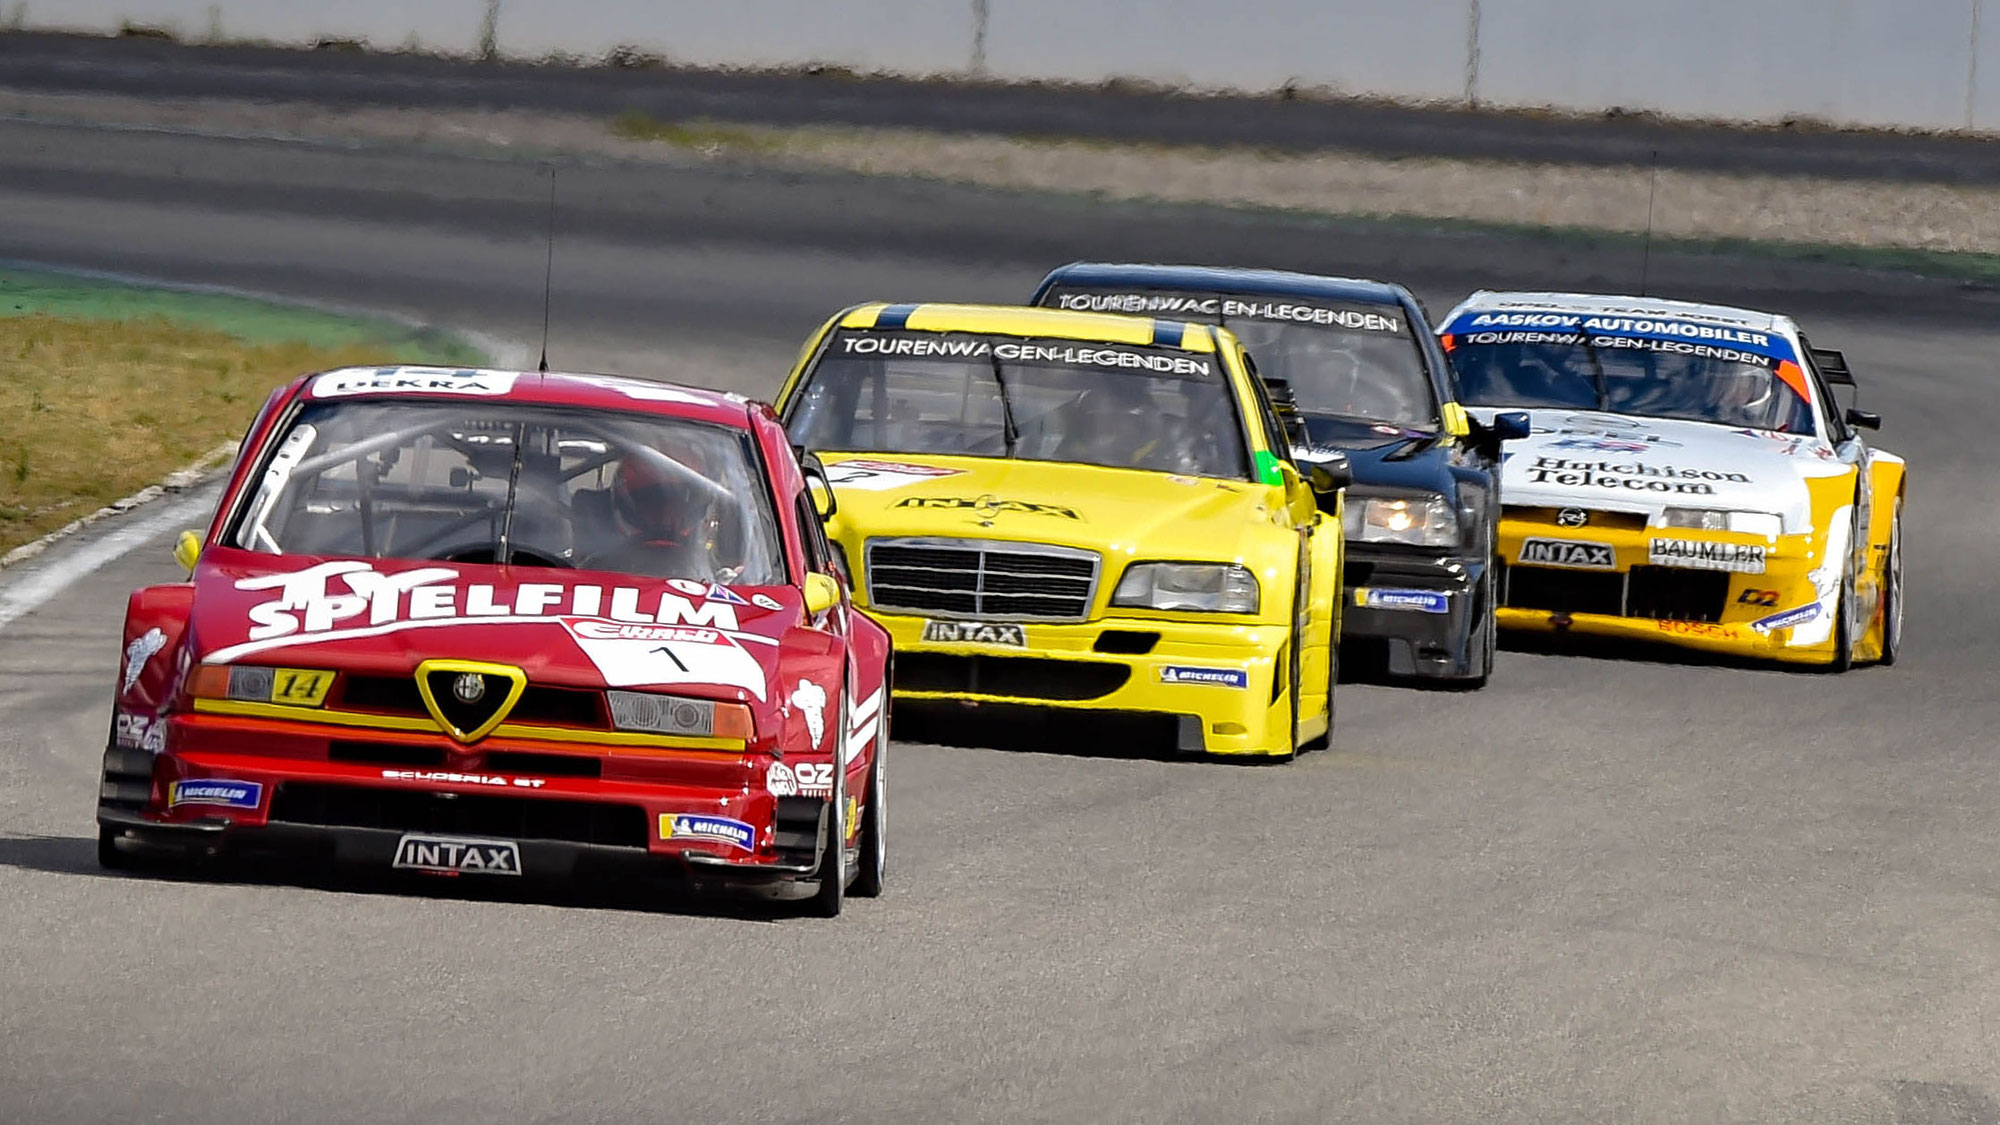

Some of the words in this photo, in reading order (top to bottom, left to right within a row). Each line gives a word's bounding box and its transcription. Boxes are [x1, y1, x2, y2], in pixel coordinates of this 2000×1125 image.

[1059, 294, 1398, 333] TOURENWAGEN-LEGENDEN
[1583, 317, 1769, 347] AUTOMOBILER
[844, 337, 1210, 377] TOURENWAGEN-LEGENDEN
[1526, 467, 1718, 495] Telecom
[1535, 455, 1753, 483] Hutchison
[1527, 543, 1609, 565] INTAX
[929, 623, 1021, 645] INTAX
[649, 646, 691, 673] 1
[277, 674, 320, 698] 14
[381, 769, 508, 786] SCUDERIA
[184, 786, 248, 800] MICHELIN
[693, 821, 749, 842] MICHELIN
[405, 842, 511, 870] INTAX
